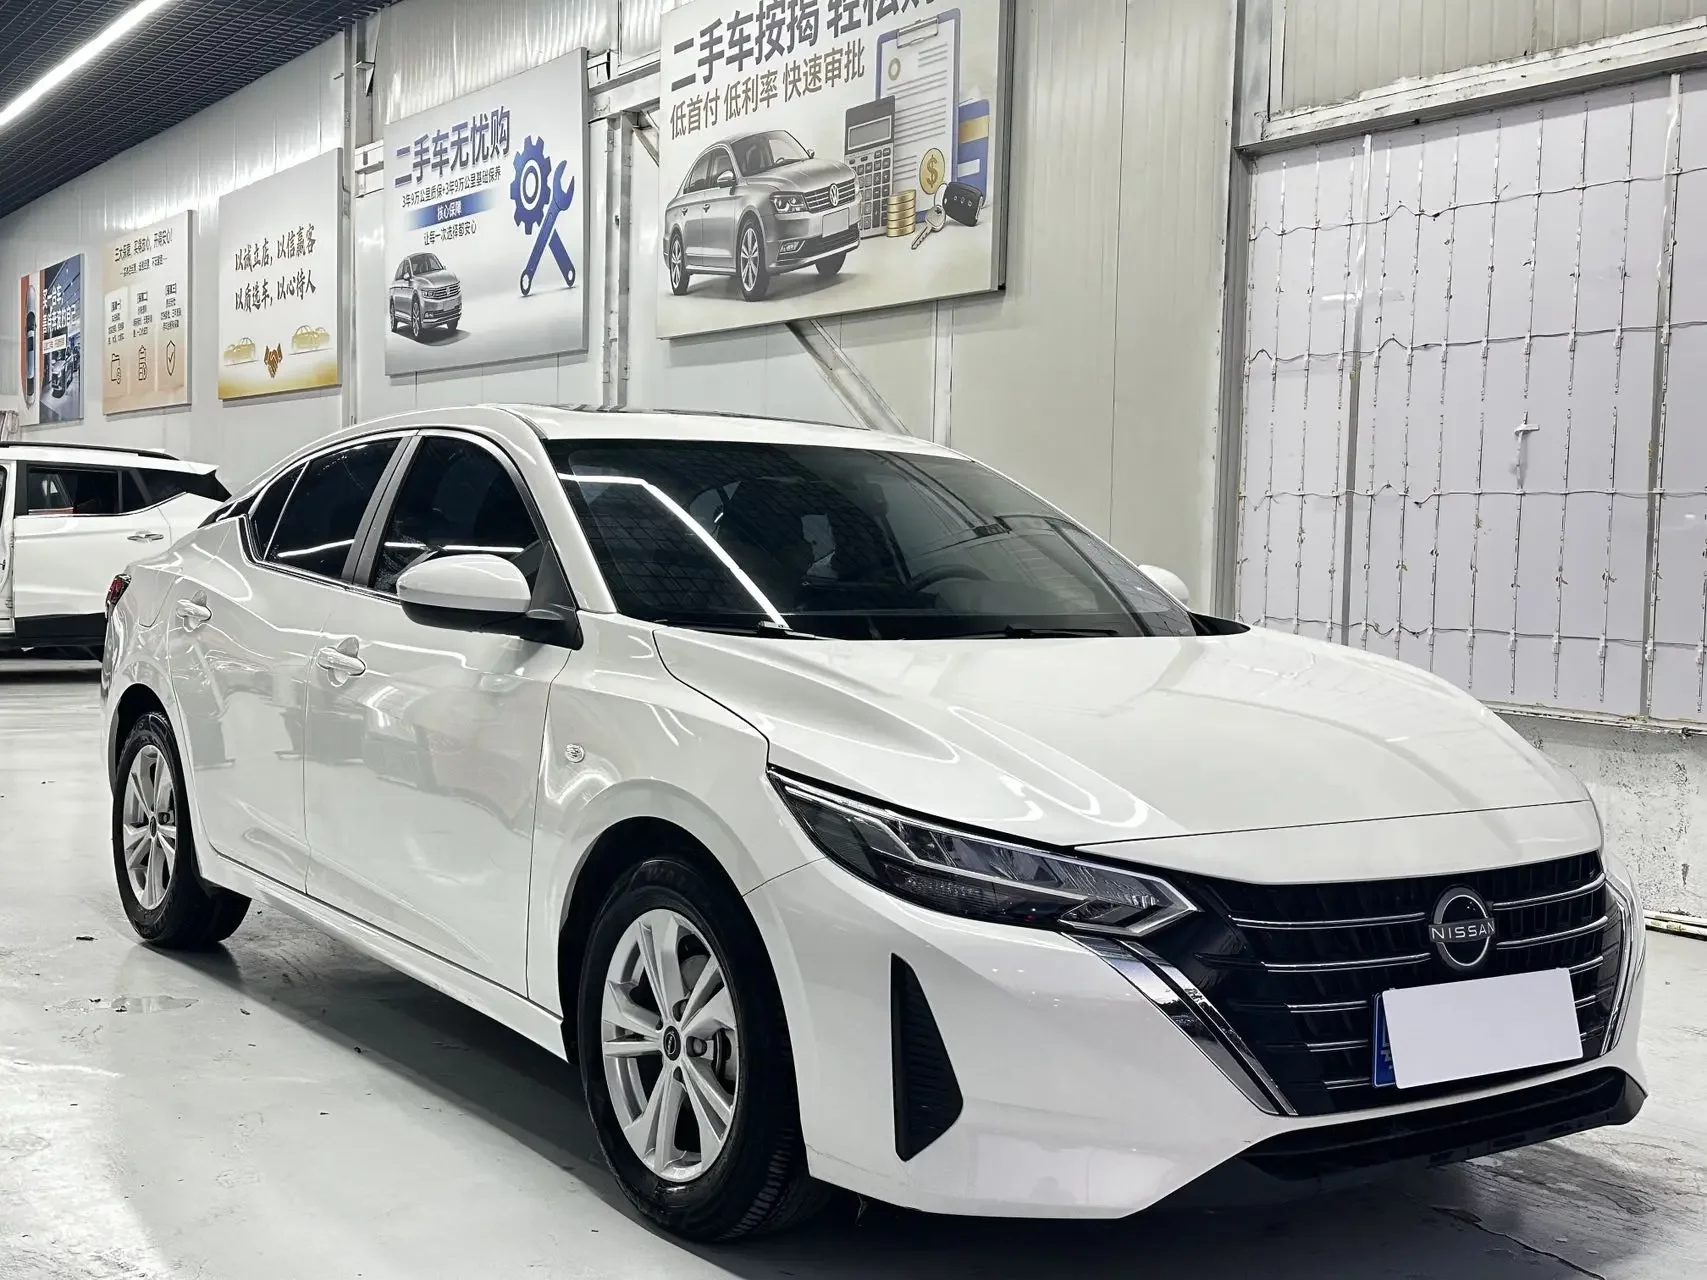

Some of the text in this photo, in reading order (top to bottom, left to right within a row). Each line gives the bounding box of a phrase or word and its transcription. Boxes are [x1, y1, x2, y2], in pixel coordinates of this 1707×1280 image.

[671, 0, 820, 92] 二手车按揭
[670, 38, 865, 140] 低首付 低利率 快速审批
[395, 106, 511, 185] 二手车无忧购
[424, 220, 477, 246] 让每一次选择都安心
[437, 201, 462, 221] 核心保障
[1432, 921, 1495, 940] NISSAN
